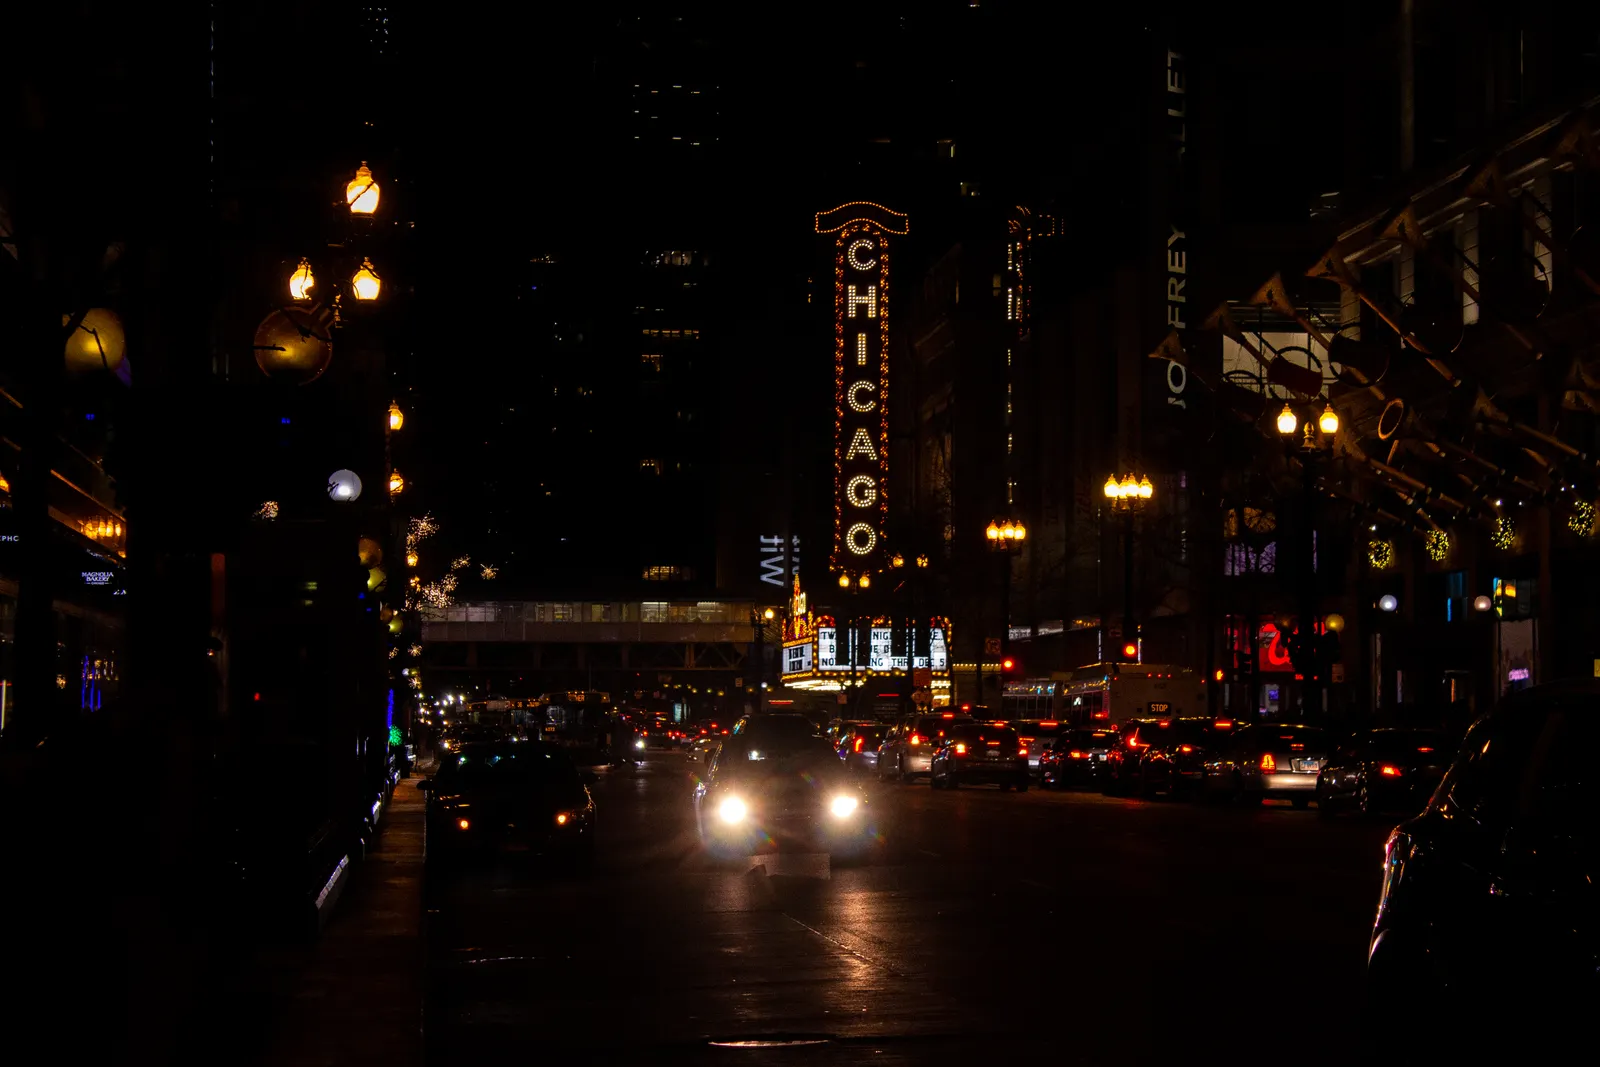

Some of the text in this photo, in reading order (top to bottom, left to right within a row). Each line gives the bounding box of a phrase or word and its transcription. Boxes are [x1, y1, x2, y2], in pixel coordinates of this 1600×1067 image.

[1166, 223, 1188, 410] JOFREY
[846, 239, 877, 555] CHICAGO
[939, 657, 945, 667] 5
[1151, 703, 1169, 712] STOP
